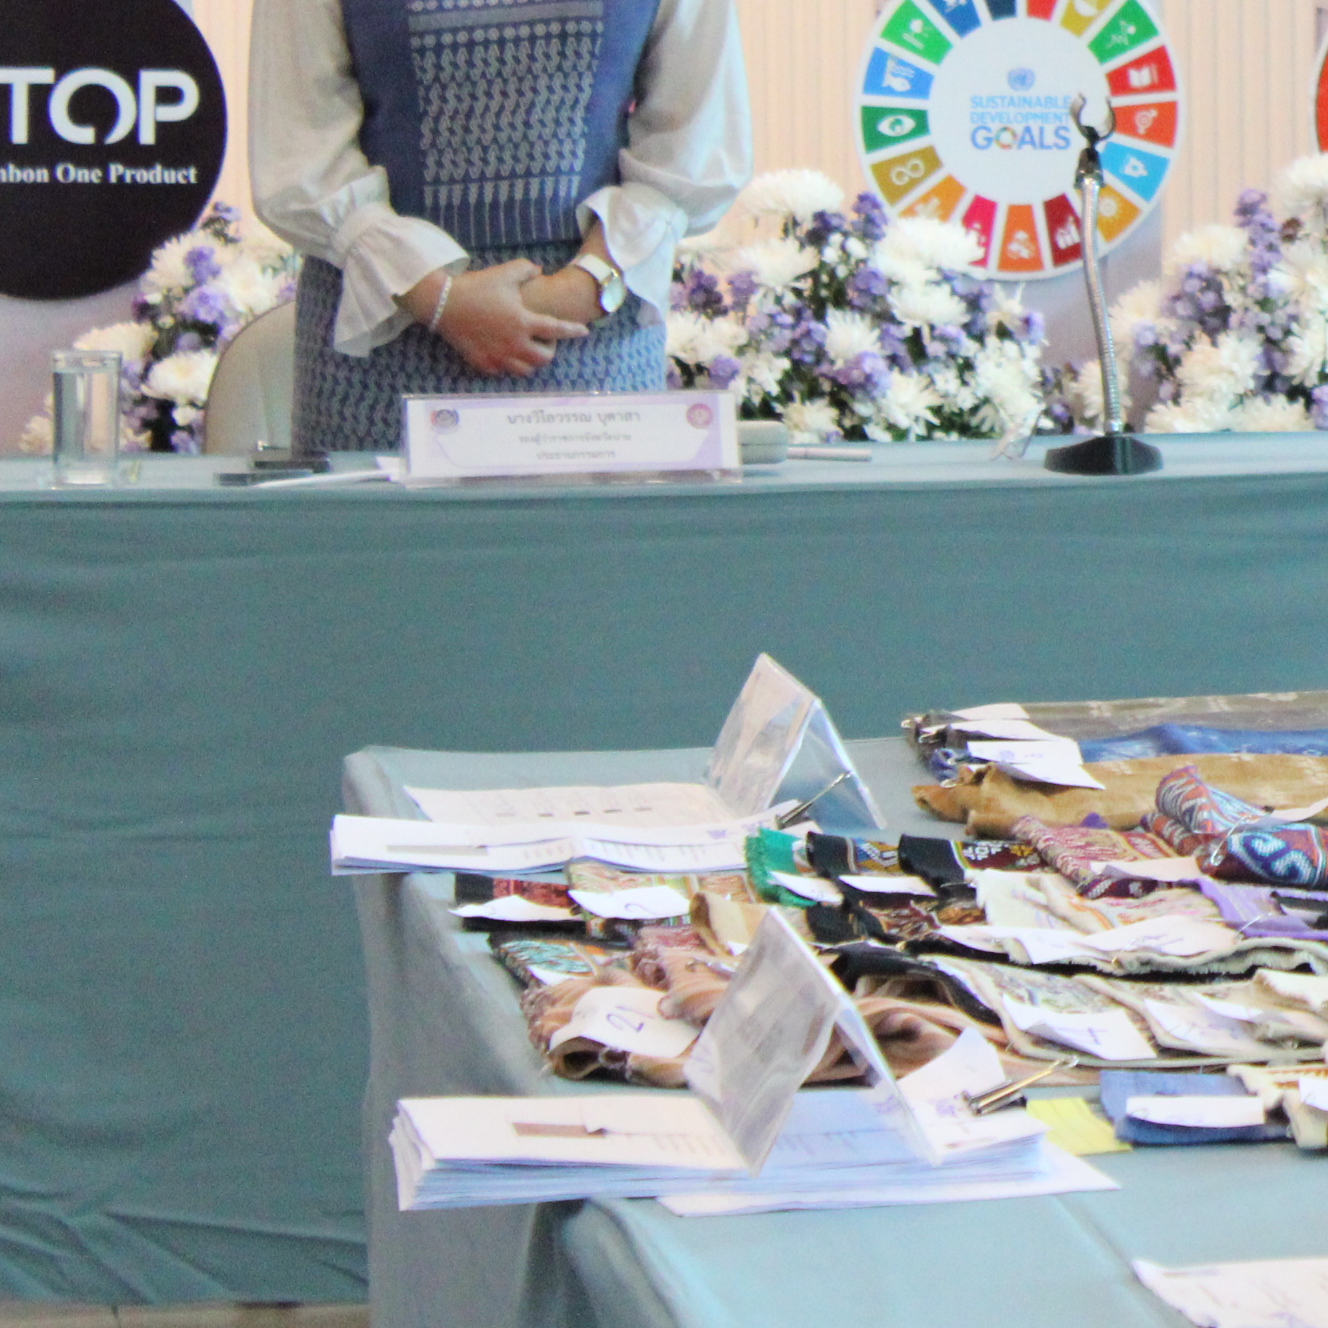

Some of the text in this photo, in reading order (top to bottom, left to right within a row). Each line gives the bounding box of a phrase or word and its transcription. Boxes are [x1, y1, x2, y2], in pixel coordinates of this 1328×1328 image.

[970, 96, 1072, 110] SUSTAINABLE
[970, 112, 1071, 125] DEVELOPMENT
[970, 127, 1072, 151] GOALS
[56, 163, 102, 184] One
[109, 164, 198, 184] Product
